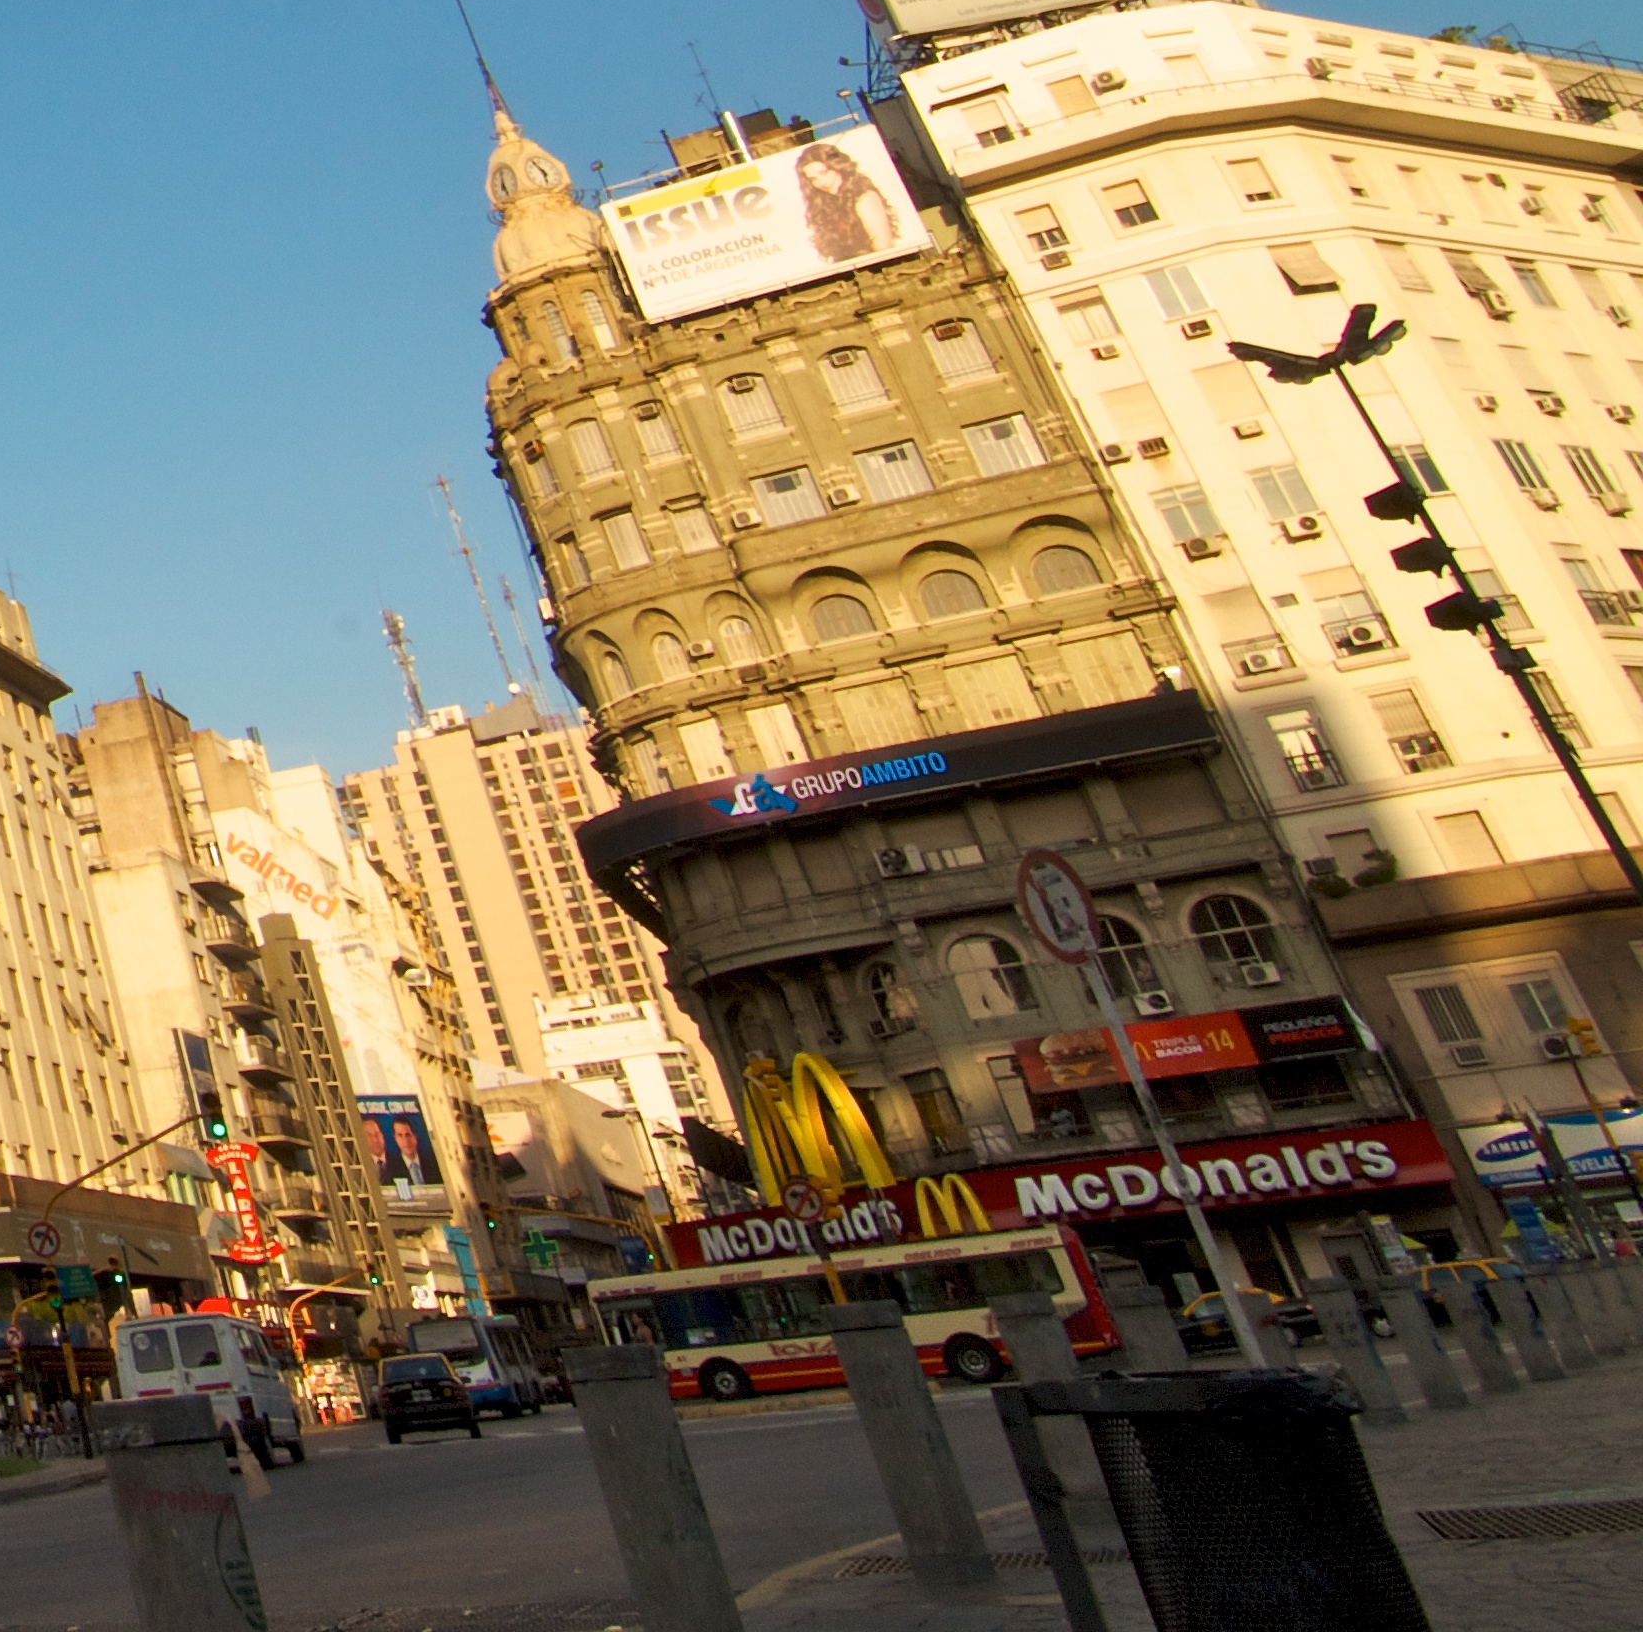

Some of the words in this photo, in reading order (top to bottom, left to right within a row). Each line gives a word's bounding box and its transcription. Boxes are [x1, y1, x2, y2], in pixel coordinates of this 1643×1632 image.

[618, 185, 773, 254] issue
[637, 264, 659, 278] LA
[661, 233, 765, 270] COLORACIÓN
[671, 267, 692, 283] DE
[694, 243, 783, 277] ARGENTINA
[225, 831, 342, 921] valmed
[1151, 1035, 1199, 1049] TRIPLE
[1155, 1045, 1203, 1059] BACON
[228, 1162, 247, 1190] LA
[1014, 1140, 1398, 1218] McDonald's
[237, 1198, 258, 1243] REY
